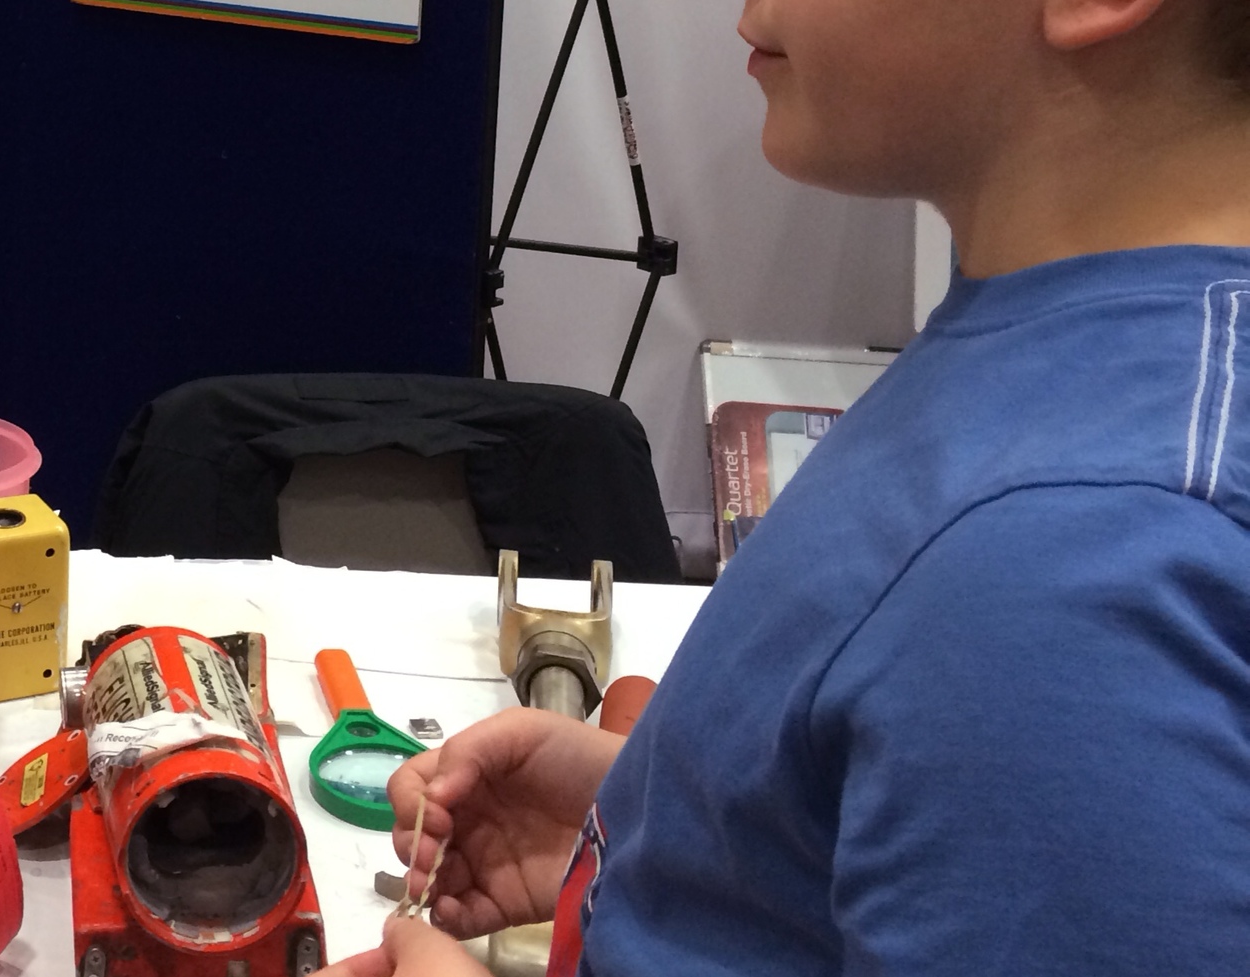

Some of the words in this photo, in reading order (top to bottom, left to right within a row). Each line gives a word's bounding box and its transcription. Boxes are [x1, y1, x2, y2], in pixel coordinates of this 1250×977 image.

[724, 447, 742, 517] Quartet
[19, 588, 51, 599] BATTERY
[7, 622, 56, 638] CORPORATION
[141, 661, 166, 714] AlliedSignal
[195, 658, 221, 710] AlliedSignal
